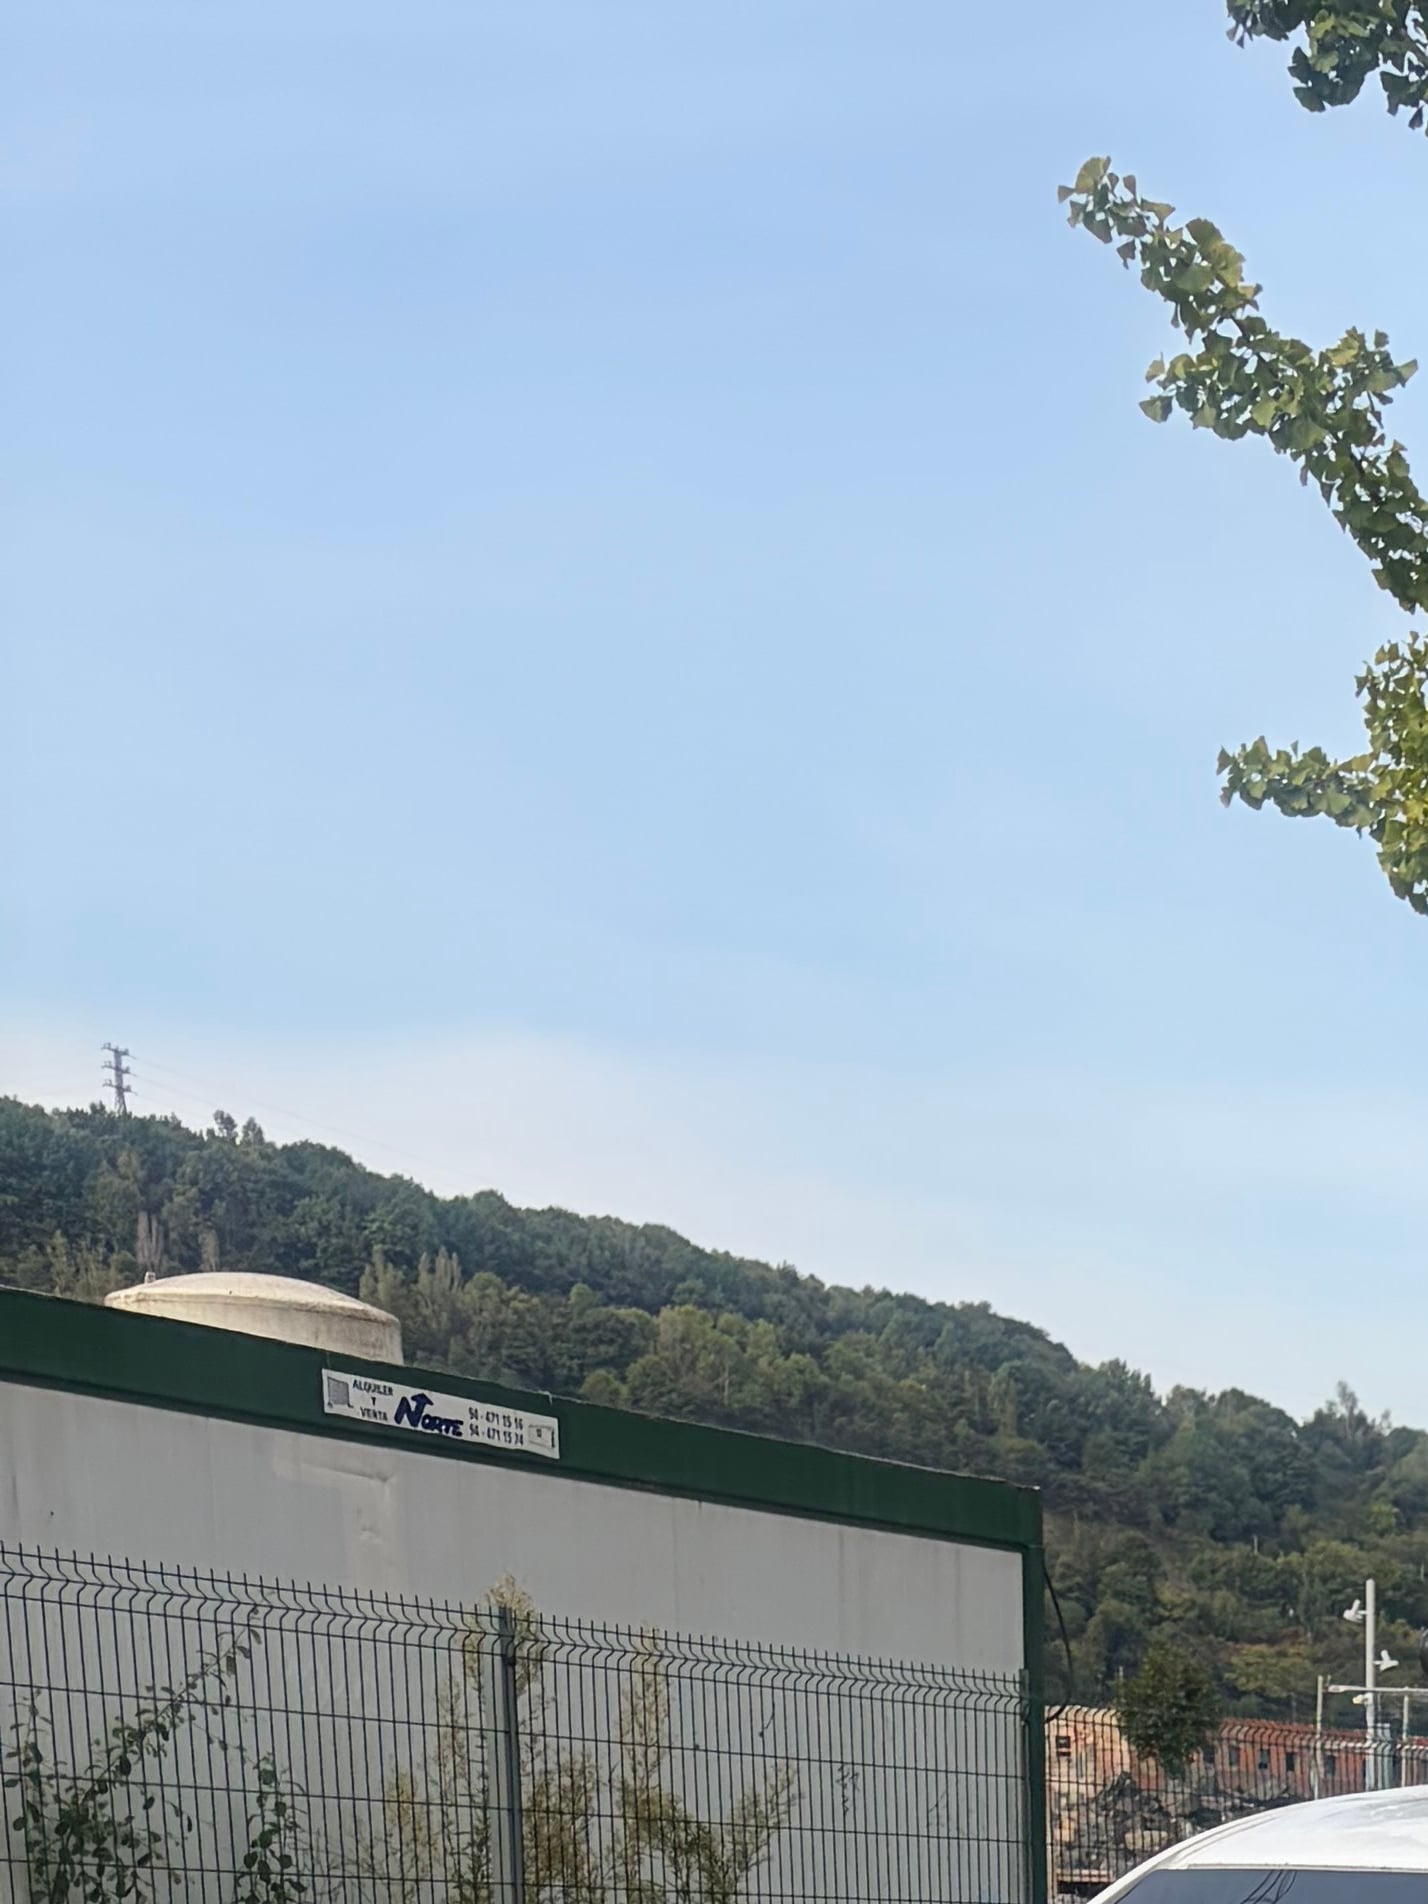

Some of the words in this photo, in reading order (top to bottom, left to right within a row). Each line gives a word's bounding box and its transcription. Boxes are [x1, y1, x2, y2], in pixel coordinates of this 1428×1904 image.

[352, 1379, 393, 1396] ALQUILER
[360, 1406, 389, 1421] VENTA
[485, 1410, 500, 1426] 471
[502, 1413, 513, 1429] 15
[486, 1426, 501, 1441] 471
[503, 1430, 513, 1444] 15
